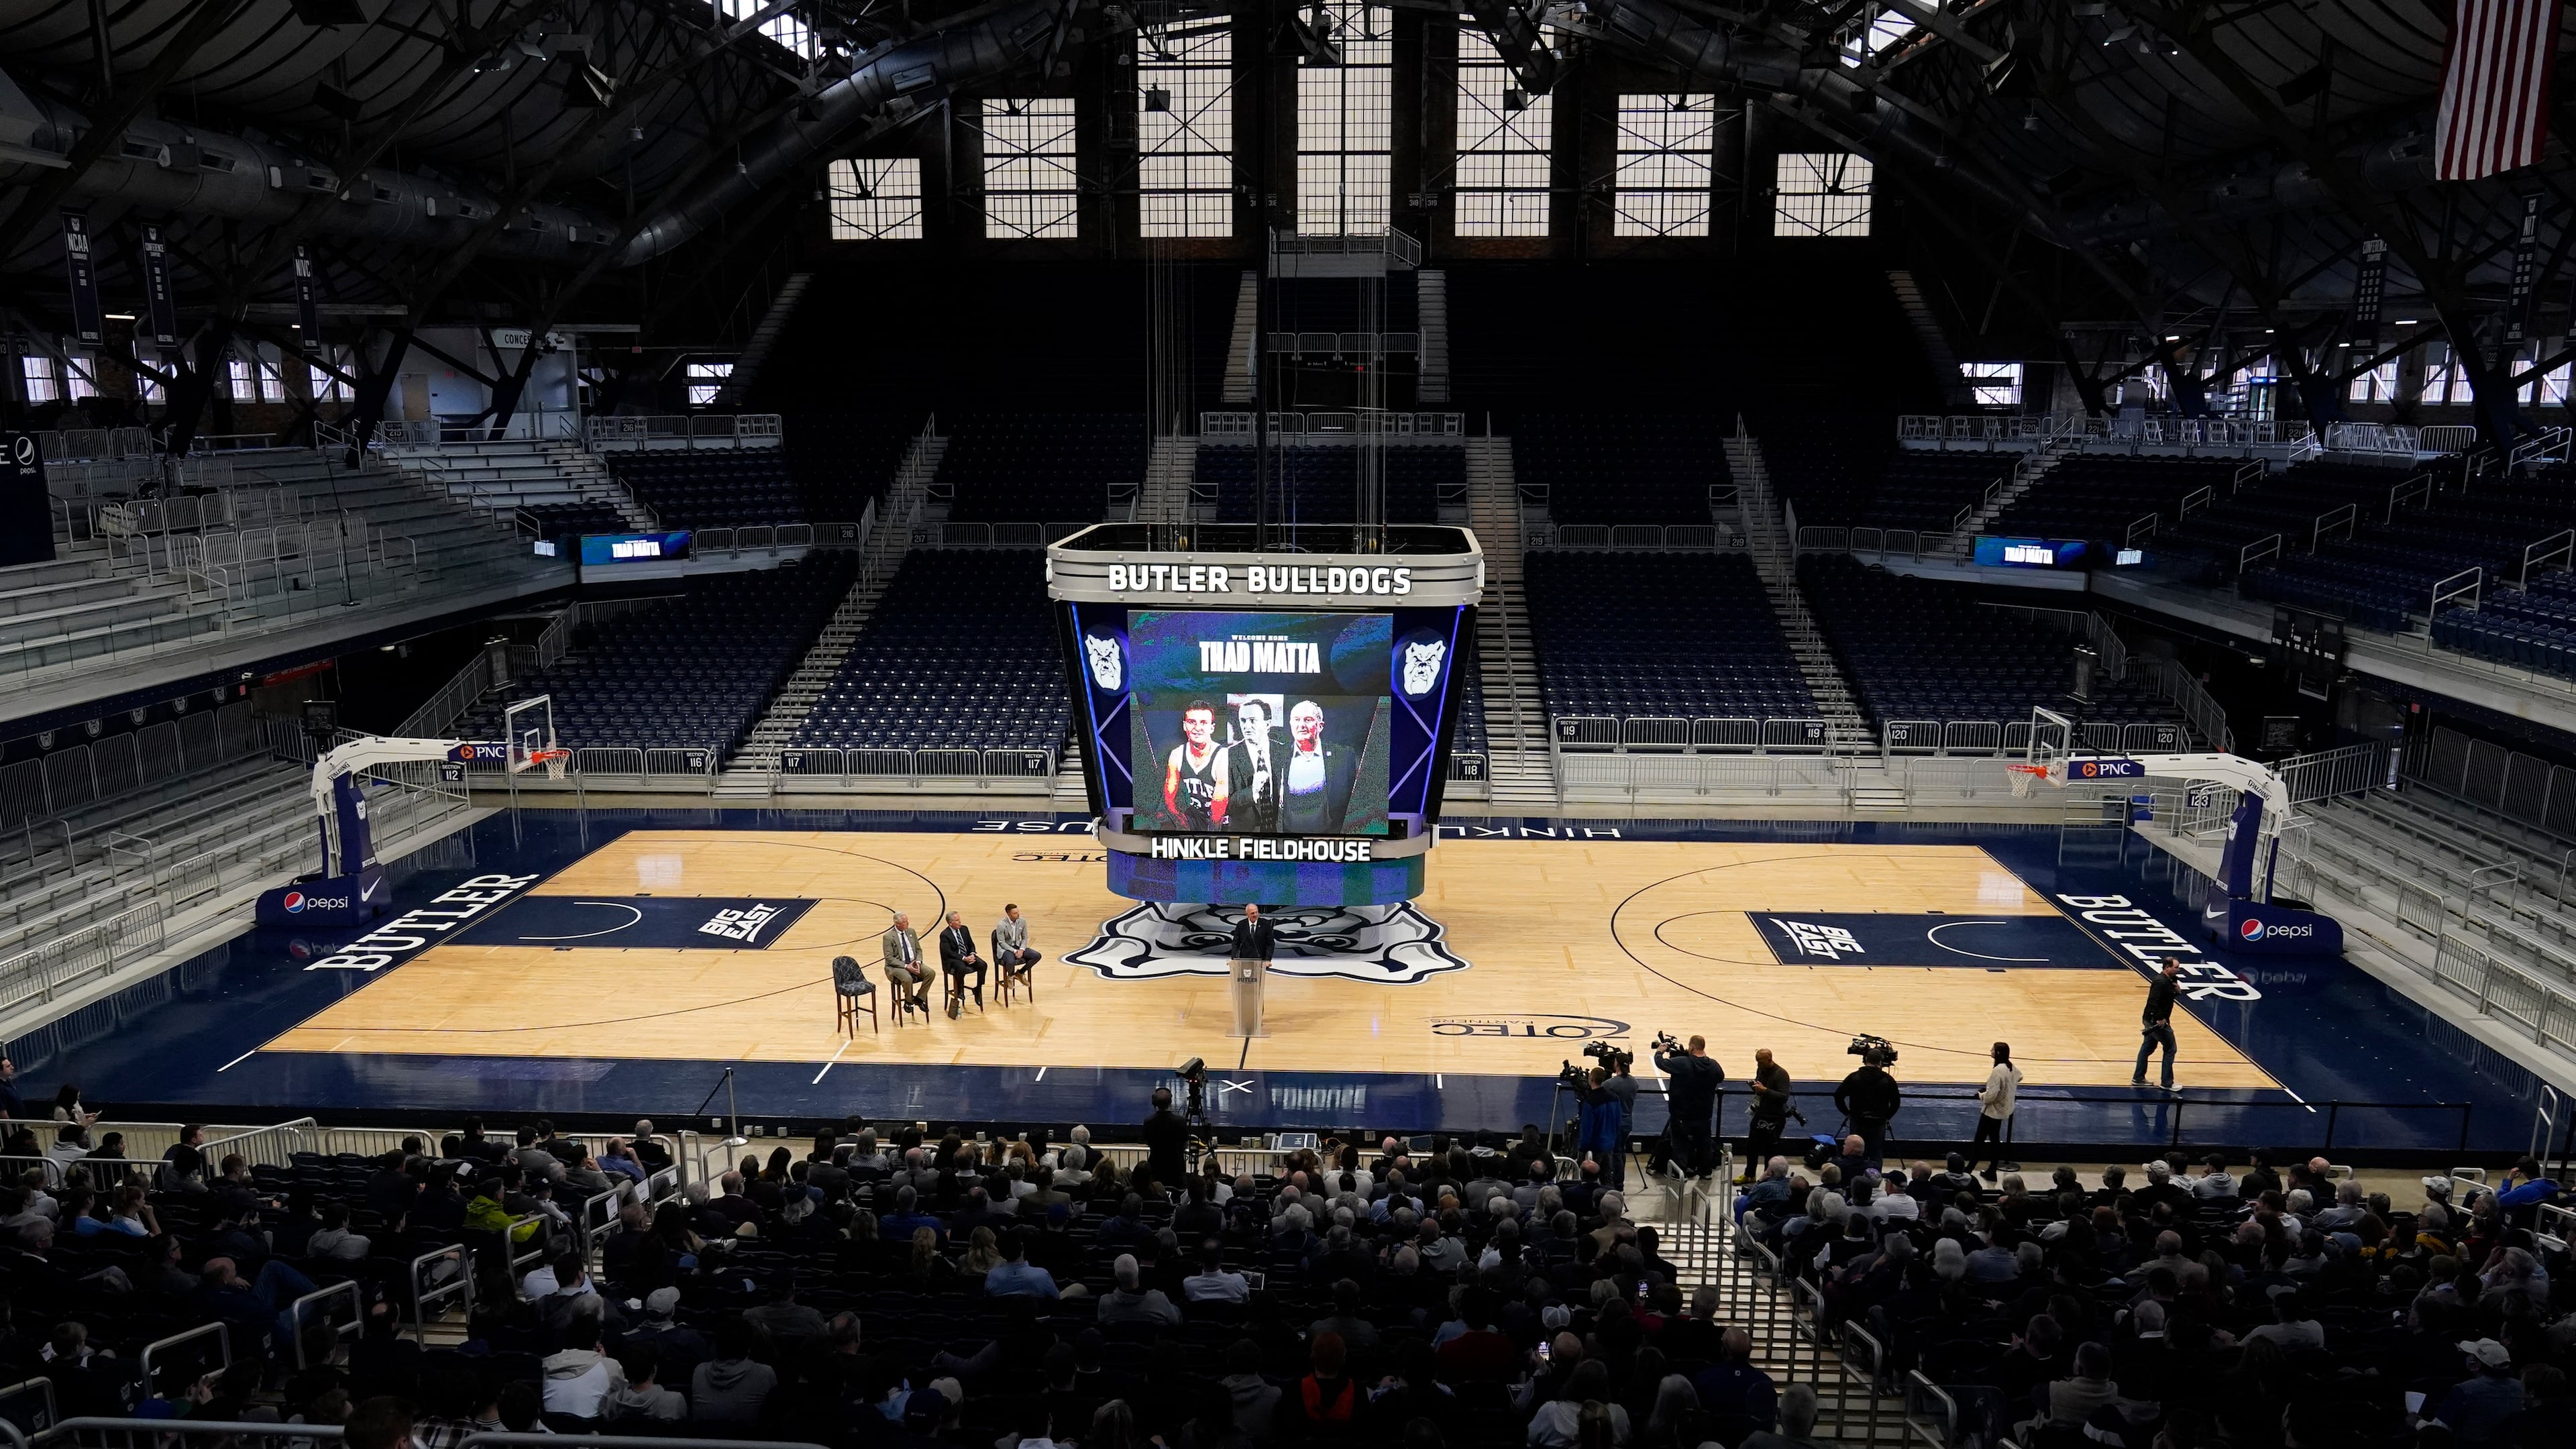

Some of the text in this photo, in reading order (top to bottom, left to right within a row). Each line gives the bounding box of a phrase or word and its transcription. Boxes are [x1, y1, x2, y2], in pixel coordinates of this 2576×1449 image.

[66, 232, 89, 253] NCAA
[623, 423, 634, 432] 216
[2022, 423, 2036, 432] 220
[842, 529, 854, 538] 216
[914, 535, 926, 543] 217
[1530, 537, 1544, 545] 219
[1731, 537, 1745, 547] 219
[1108, 564, 1412, 595] BUTLER BULLDOGS
[1199, 641, 1321, 674] THAD MATTA
[1563, 725, 1575, 736] 119
[1807, 728, 1821, 738] 119
[1891, 730, 1907, 739] 120
[2157, 733, 2174, 743] 120
[476, 746, 505, 758] PNC
[690, 757, 702, 767] 116
[788, 757, 800, 767] 117
[1028, 759, 1040, 769] 117
[327, 761, 350, 782] SPALDING
[1464, 765, 1478, 775] 118
[2099, 763, 2131, 775] PNC
[445, 770, 458, 781] 112
[2247, 780, 2272, 802] SPALDING
[2191, 795, 2209, 806] 123
[1151, 837, 1371, 861] HINKLE FIELDHOUSE
[307, 896, 348, 911] pepsi
[303, 873, 540, 971] BUTLER
[698, 908, 745, 936] BIG
[720, 902, 778, 940] EAST
[2266, 924, 2312, 938] pepsi
[1786, 920, 1841, 961] EAST
[1817, 924, 1866, 954] BIG
[2056, 894, 2262, 1001] BUTLER
